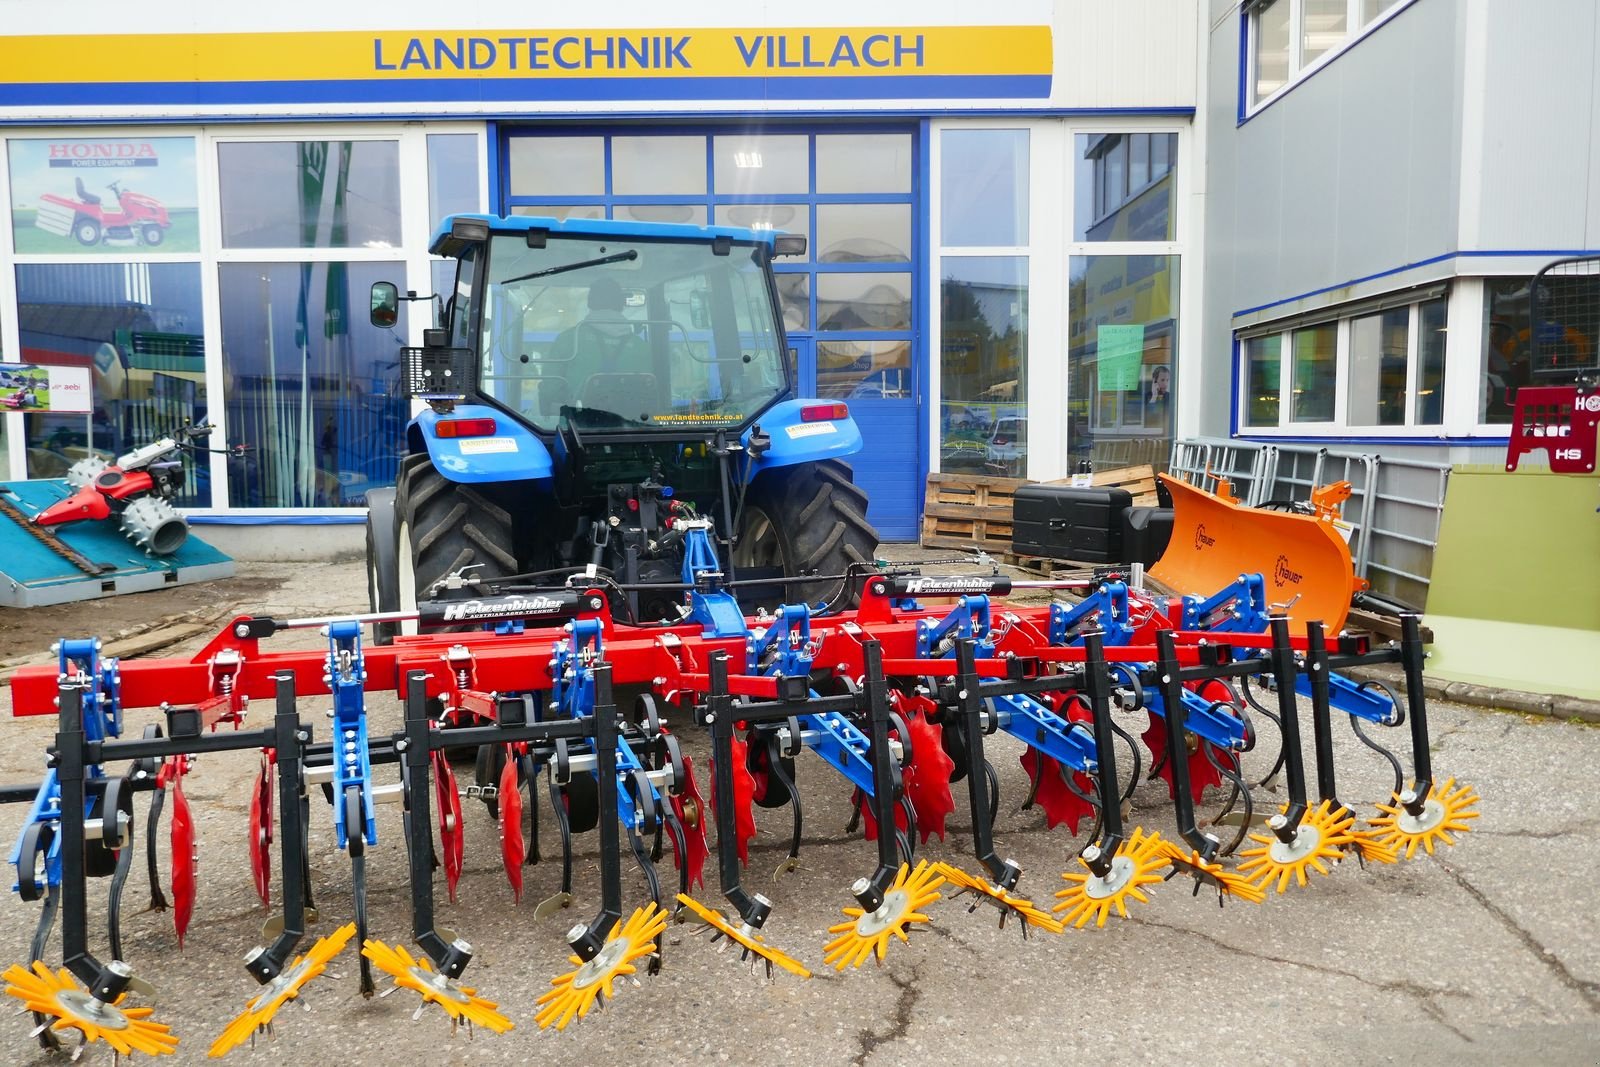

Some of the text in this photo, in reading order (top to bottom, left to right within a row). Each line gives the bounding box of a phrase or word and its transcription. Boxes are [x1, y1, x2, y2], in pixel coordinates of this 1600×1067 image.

[374, 35, 925, 70] LANDTECHNIK VILLACH
[48, 144, 157, 158] HONDA
[71, 159, 136, 167] POWER EQUIPMENT
[1556, 449, 1581, 459] HS
[1199, 531, 1215, 546] hauer
[1279, 563, 1302, 584] hauer
[906, 579, 996, 593] Hatzenbichler
[444, 600, 565, 620] Hatzenbichler
